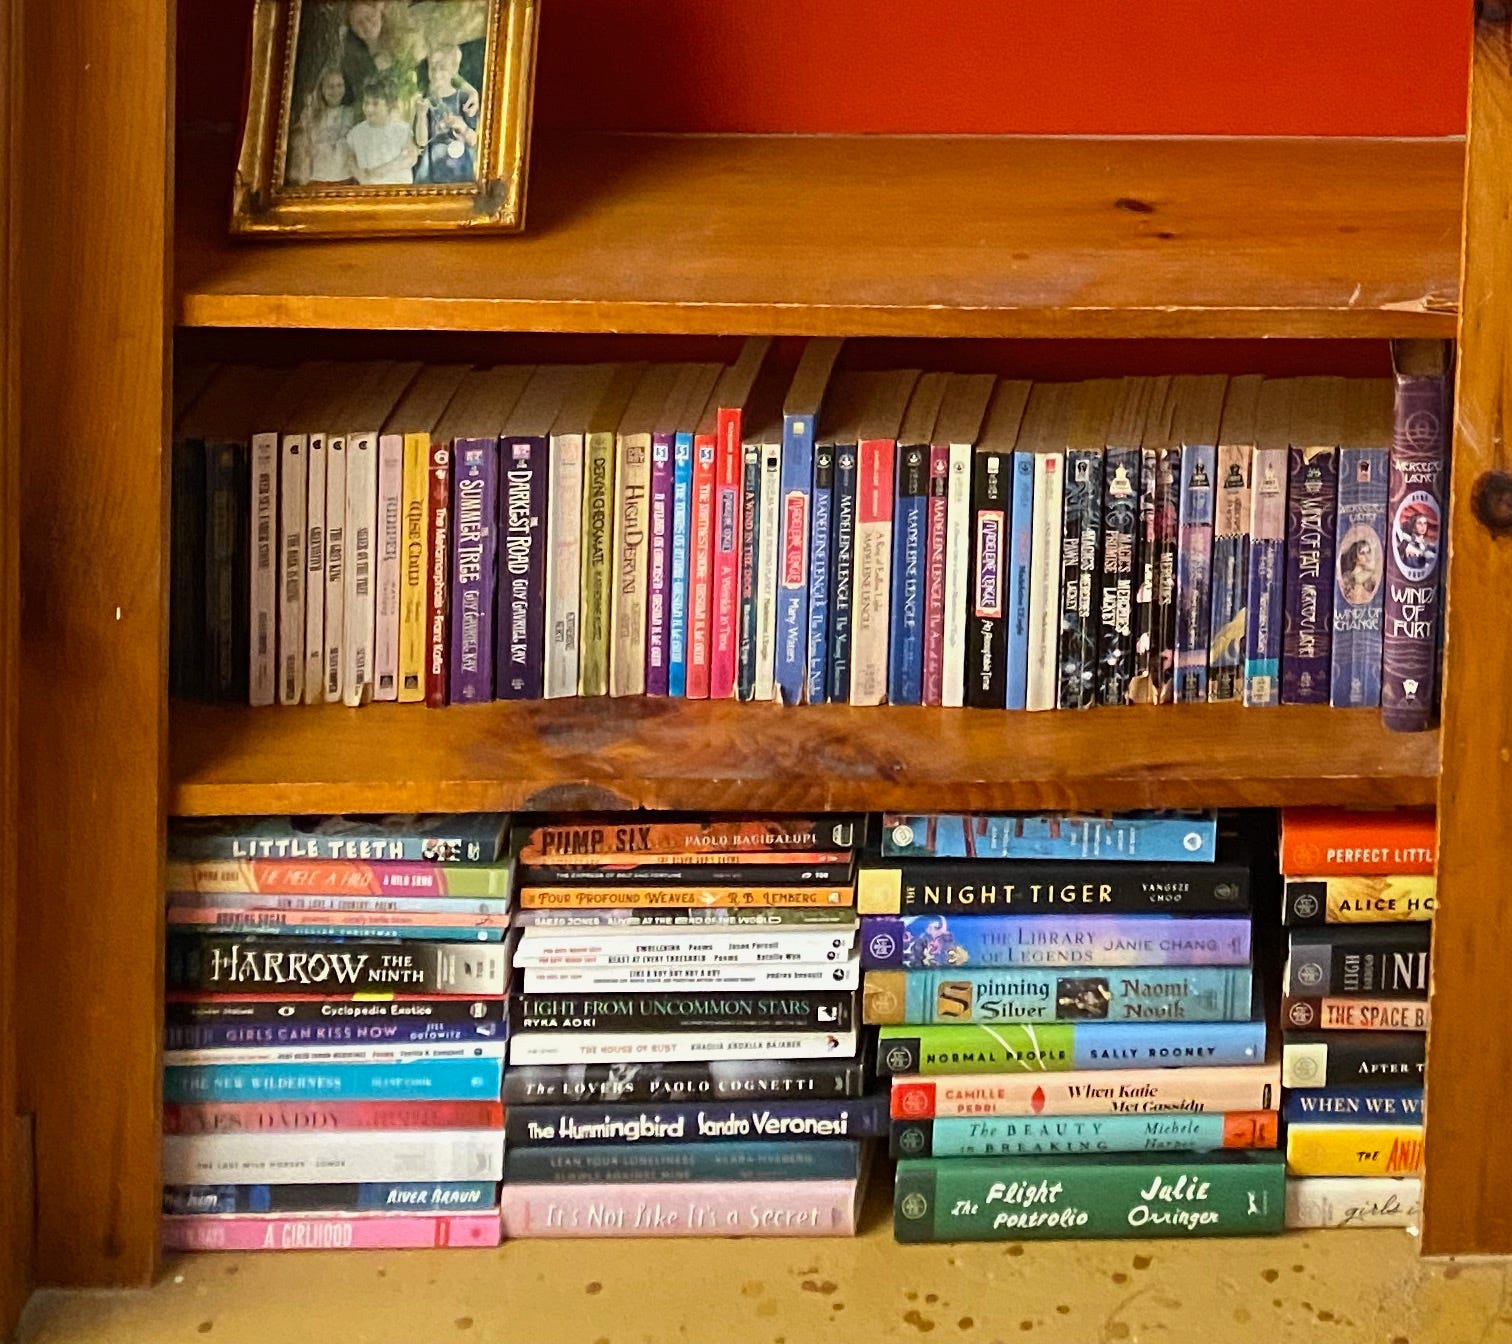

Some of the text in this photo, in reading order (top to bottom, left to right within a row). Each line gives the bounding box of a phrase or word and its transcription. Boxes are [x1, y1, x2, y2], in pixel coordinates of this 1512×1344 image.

[232, 840, 403, 859] LITTLE TEETH
[924, 885, 1113, 904] NIGHT TIGER
[211, 945, 369, 984] HARROW
[382, 956, 413, 967] THE
[368, 970, 424, 983] NINTH
[528, 1115, 684, 1141] The Hummingbird
[697, 1111, 848, 1137] Sandro Veronesi
